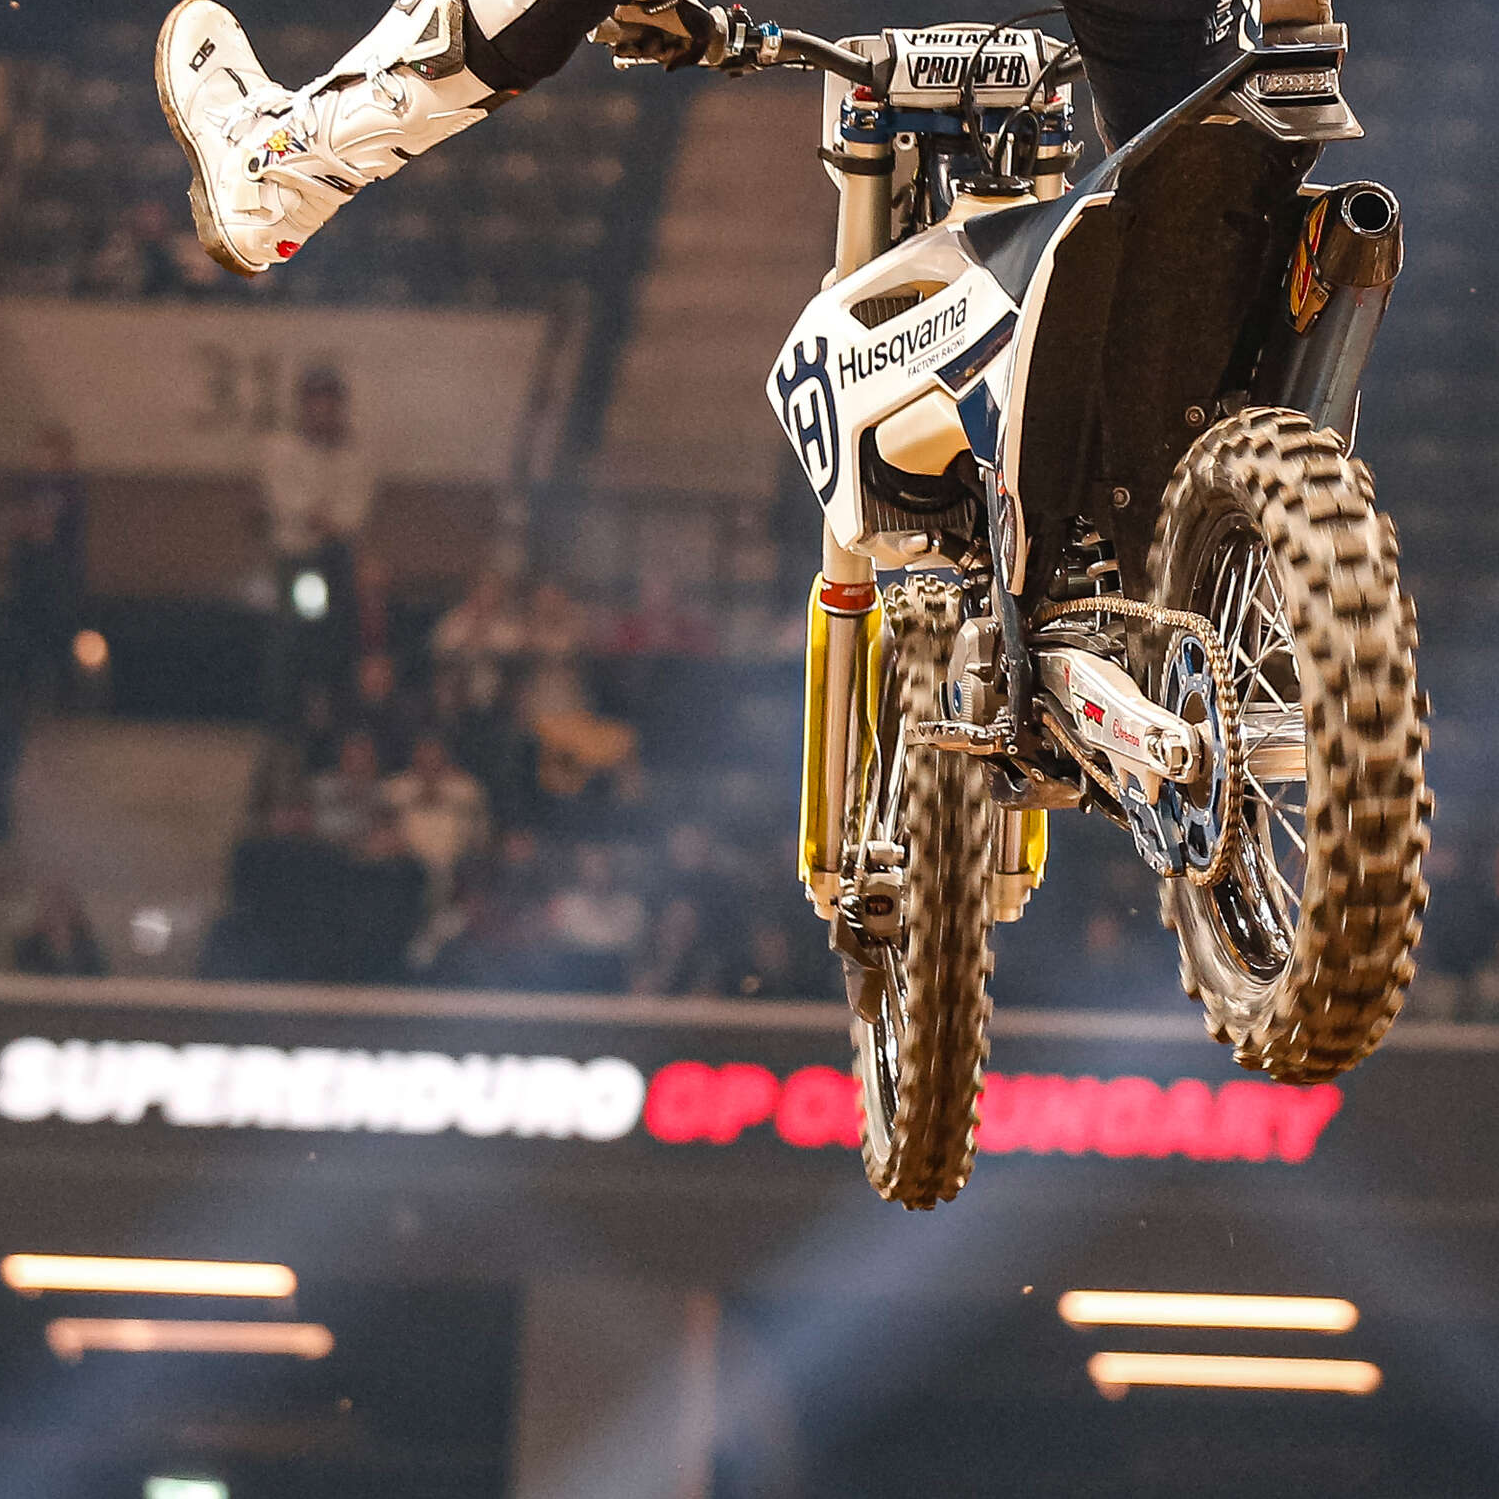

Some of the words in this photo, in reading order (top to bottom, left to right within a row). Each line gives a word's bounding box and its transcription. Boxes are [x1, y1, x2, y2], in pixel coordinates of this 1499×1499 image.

[913, 55, 1024, 87] PROTAPER
[838, 297, 967, 389] Husqvarna
[973, 1073, 1342, 1162] UNGARY
